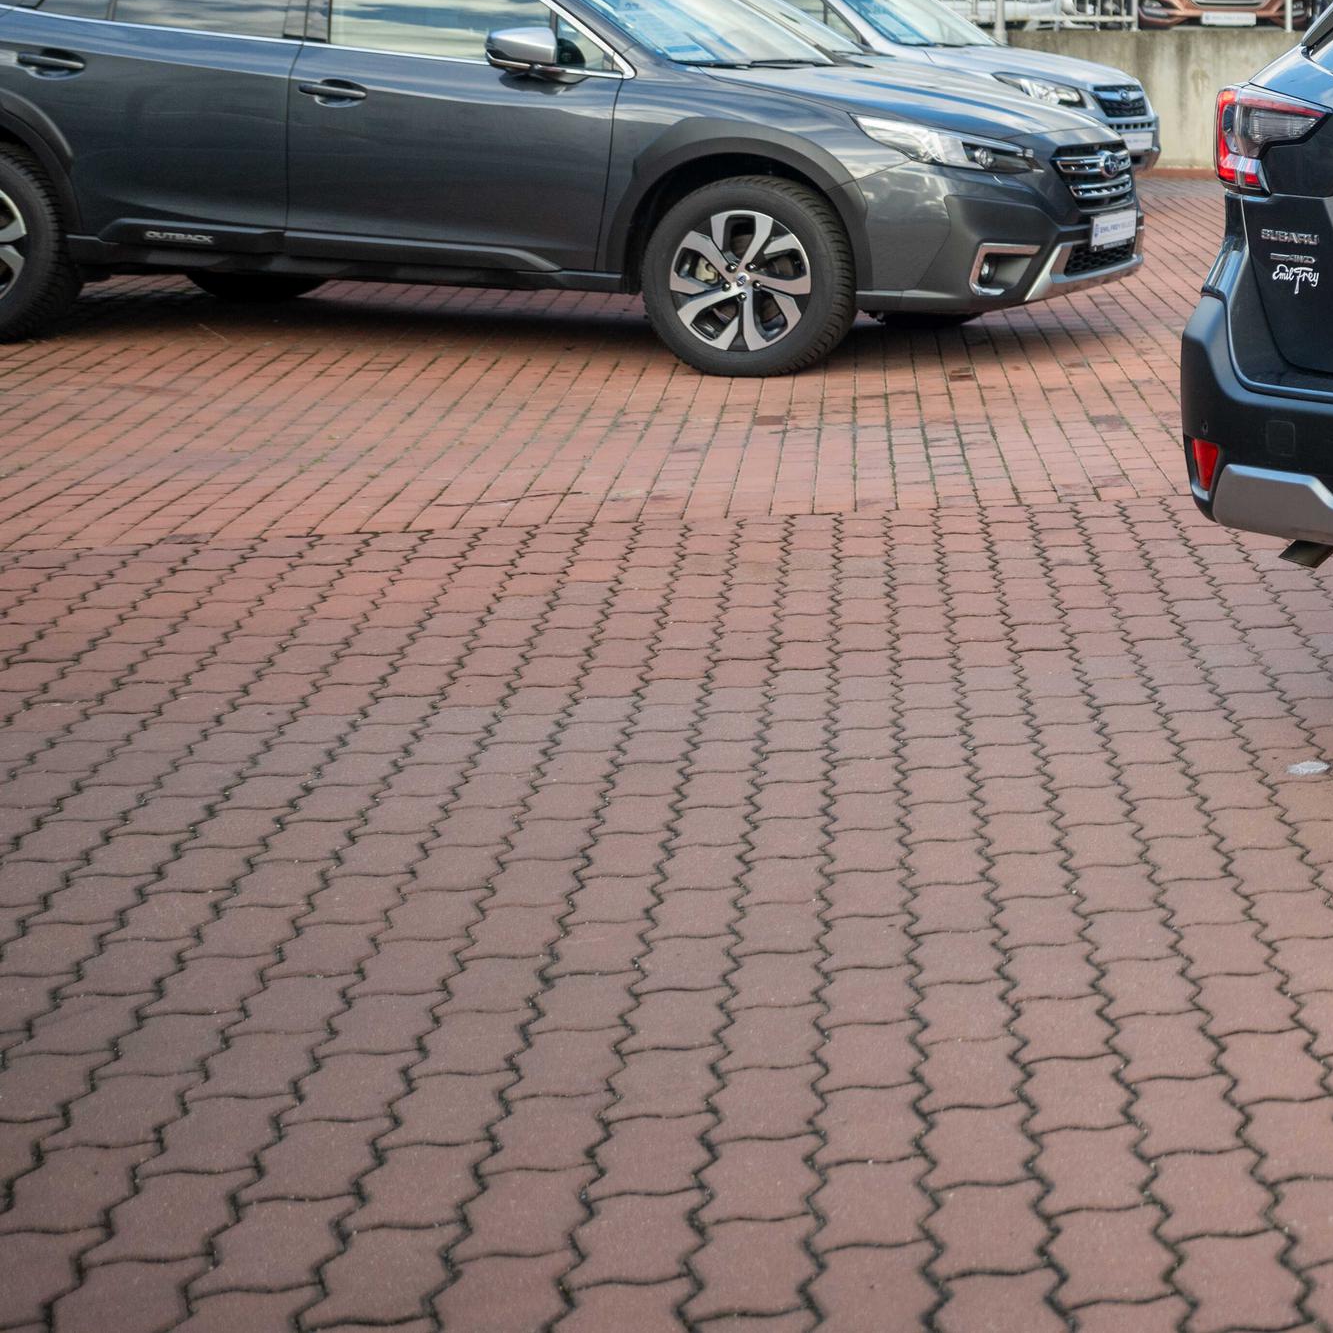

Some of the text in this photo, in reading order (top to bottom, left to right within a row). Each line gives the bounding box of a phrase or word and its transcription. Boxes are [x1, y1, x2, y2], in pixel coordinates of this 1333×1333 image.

[144, 230, 214, 244] OUTBACK
[1260, 228, 1320, 246] SUBARU
[1272, 263, 1320, 295] Emil Frey
